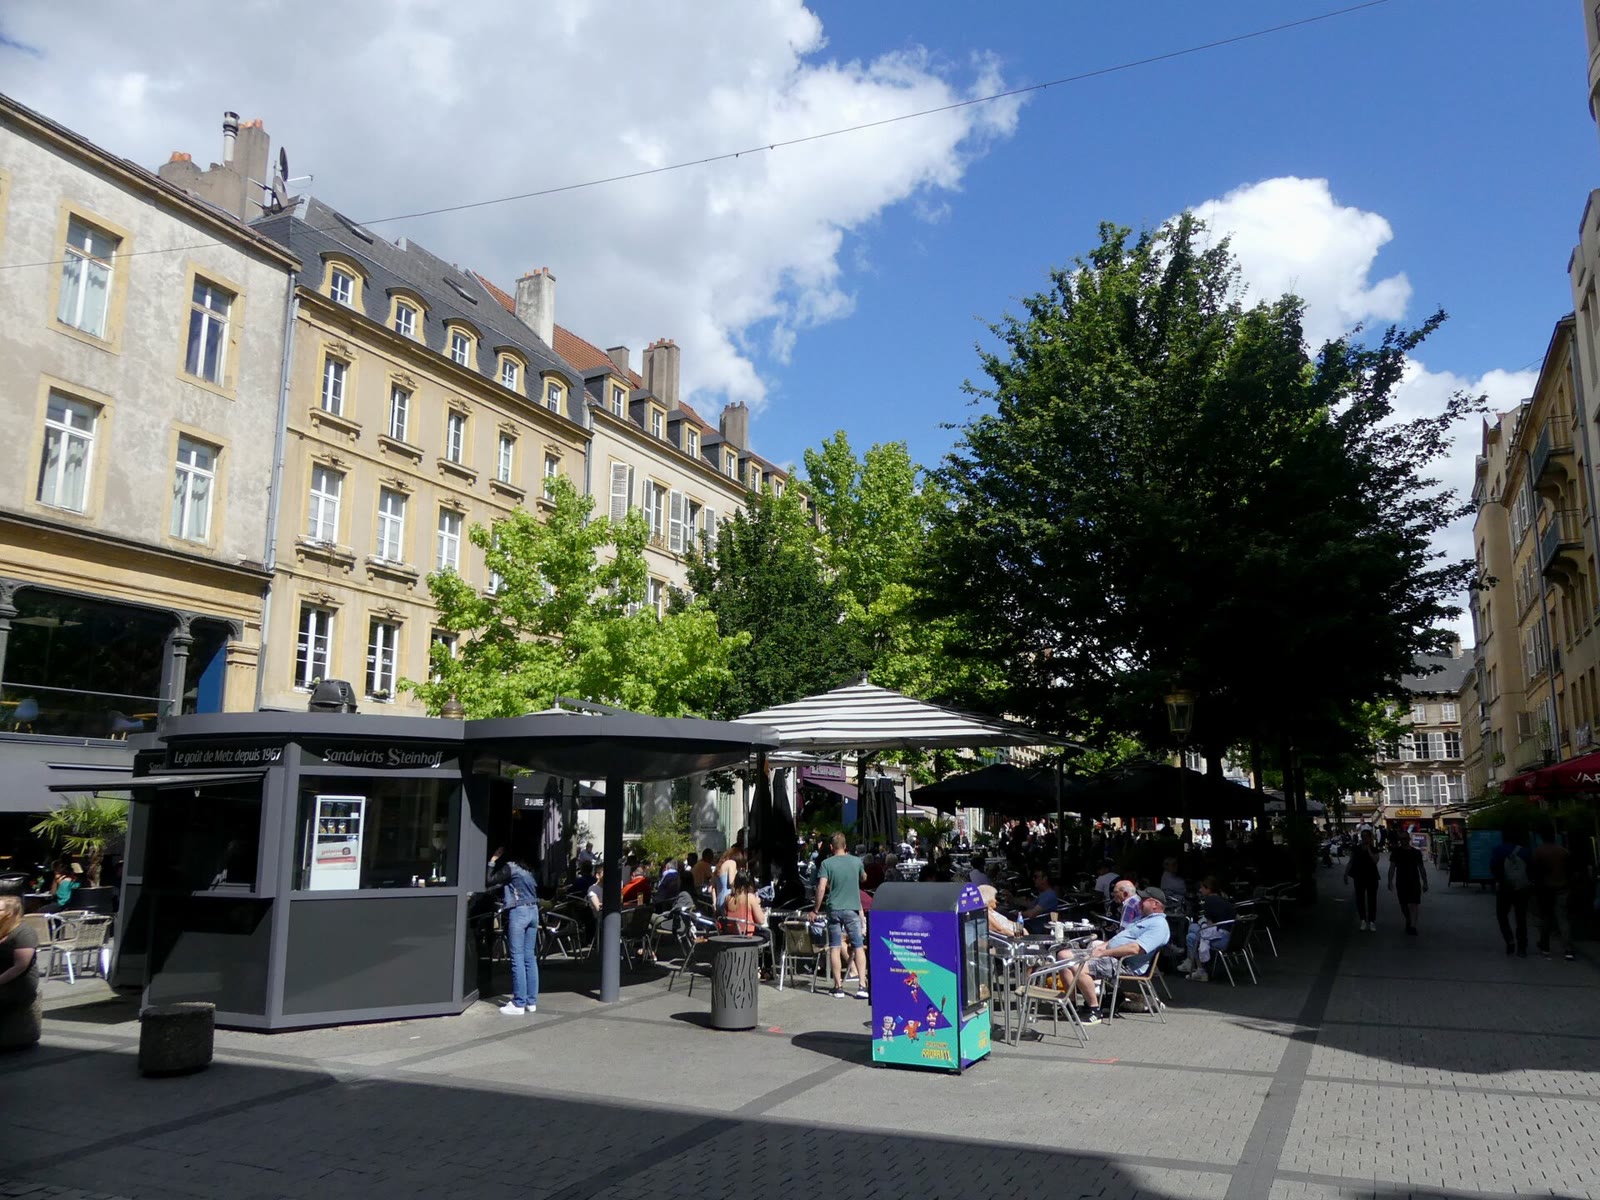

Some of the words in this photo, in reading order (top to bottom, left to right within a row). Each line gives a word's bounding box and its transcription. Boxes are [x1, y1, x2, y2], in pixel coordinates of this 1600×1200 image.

[174, 751, 184, 763] Le
[184, 749, 203, 767] goût
[203, 749, 214, 762] de
[212, 748, 233, 762] Metz
[234, 748, 260, 765] depuis
[262, 747, 282, 761] 1967
[322, 748, 384, 763] Sandwichs
[387, 747, 443, 768] Steinhoff
